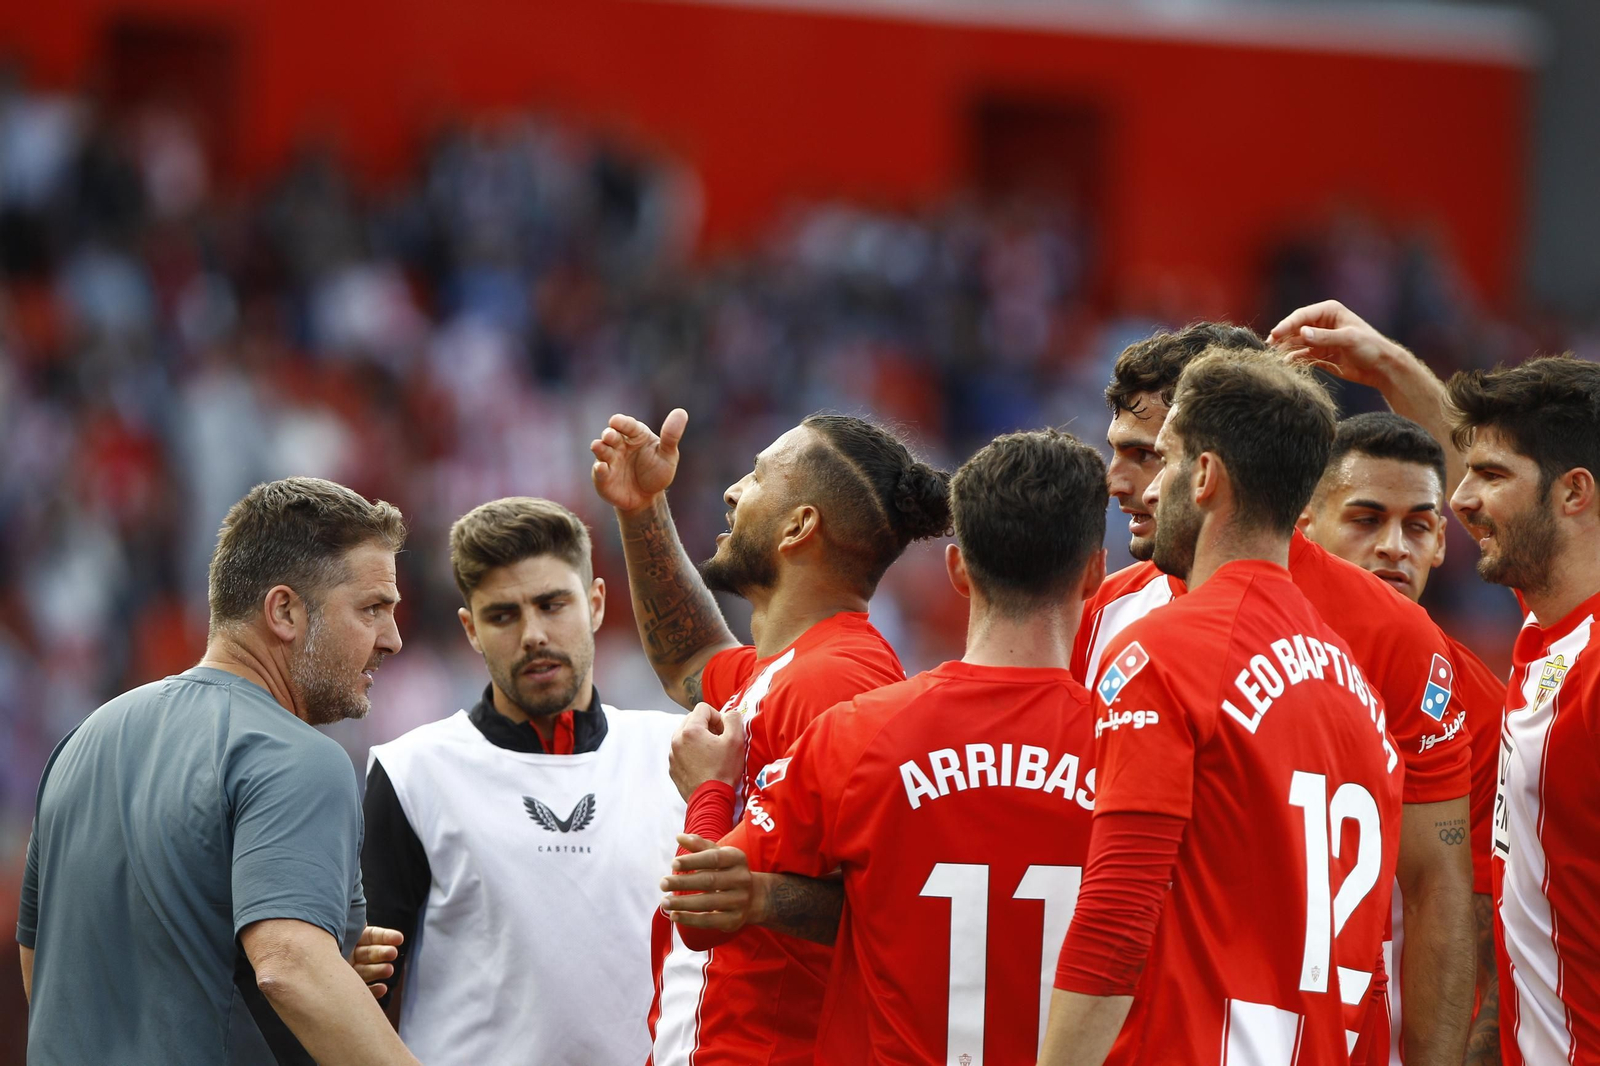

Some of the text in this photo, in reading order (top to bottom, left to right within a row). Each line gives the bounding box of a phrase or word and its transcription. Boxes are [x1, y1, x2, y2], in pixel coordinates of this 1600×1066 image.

[1221, 654, 1285, 734] LEO
[537, 845, 592, 854] CASTORE
[1289, 770, 1382, 1005] 12
[919, 863, 1083, 1066] 11
